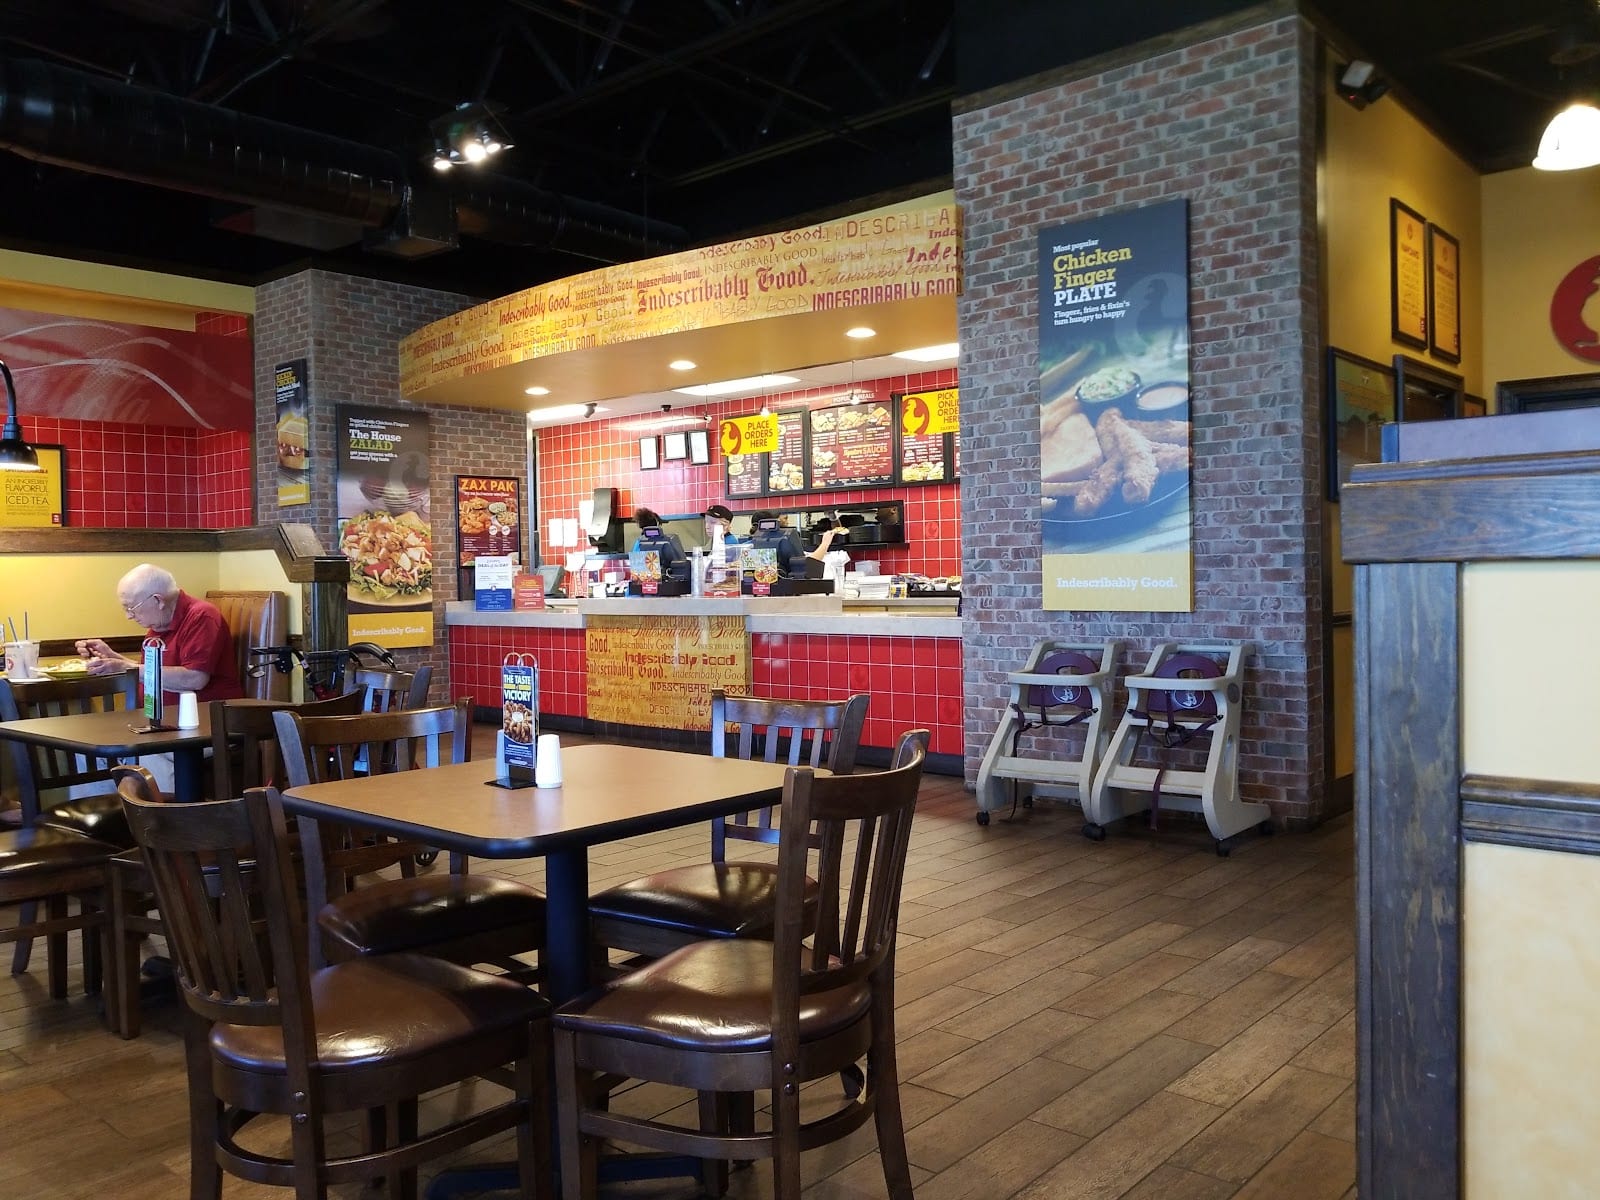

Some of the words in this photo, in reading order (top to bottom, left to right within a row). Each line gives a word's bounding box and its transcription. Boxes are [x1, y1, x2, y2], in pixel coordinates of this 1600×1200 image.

[1052, 244, 1071, 253] Most
[1071, 239, 1099, 251] popular
[704, 254, 779, 273] INDESCRIBABLY
[783, 248, 818, 261] GOOD
[1053, 247, 1132, 272] Chicken
[1053, 267, 1117, 289] Finger
[637, 272, 749, 316] Indescribably
[755, 261, 815, 292] Good.
[1053, 281, 1117, 306] PLATE
[499, 292, 546, 326] Indescribably
[549, 283, 572, 312] Good.
[1083, 305, 1100, 313] fries
[1100, 303, 1107, 311] &
[1053, 317, 1069, 326] turn
[1069, 314, 1094, 324] hungry
[1102, 309, 1126, 319] happy
[431, 344, 479, 373] Indescribably
[481, 334, 507, 358] Good.
[937, 392, 954, 400] PICK
[938, 407, 959, 416] ORDE
[747, 420, 770, 430] PLACE
[944, 416, 960, 424] HER
[349, 428, 370, 440] The
[370, 430, 402, 442] House
[744, 429, 774, 440] ORDERS
[350, 438, 394, 451] ZALAD
[750, 439, 768, 448] HERE
[862, 445, 888, 453] SAUCES
[5, 484, 48, 492] FLAVORFUL
[460, 480, 487, 490] ZAX
[490, 480, 515, 492] PAK
[6, 496, 29, 504] ICED
[31, 496, 50, 505] TEA
[1056, 576, 1138, 590] Indescribably
[1140, 576, 1178, 588] Good.
[590, 633, 611, 653] Good.
[638, 663, 668, 679] Good.
[504, 674, 514, 684] THE
[515, 674, 531, 685] TASTE
[504, 690, 532, 702] VICTORY
